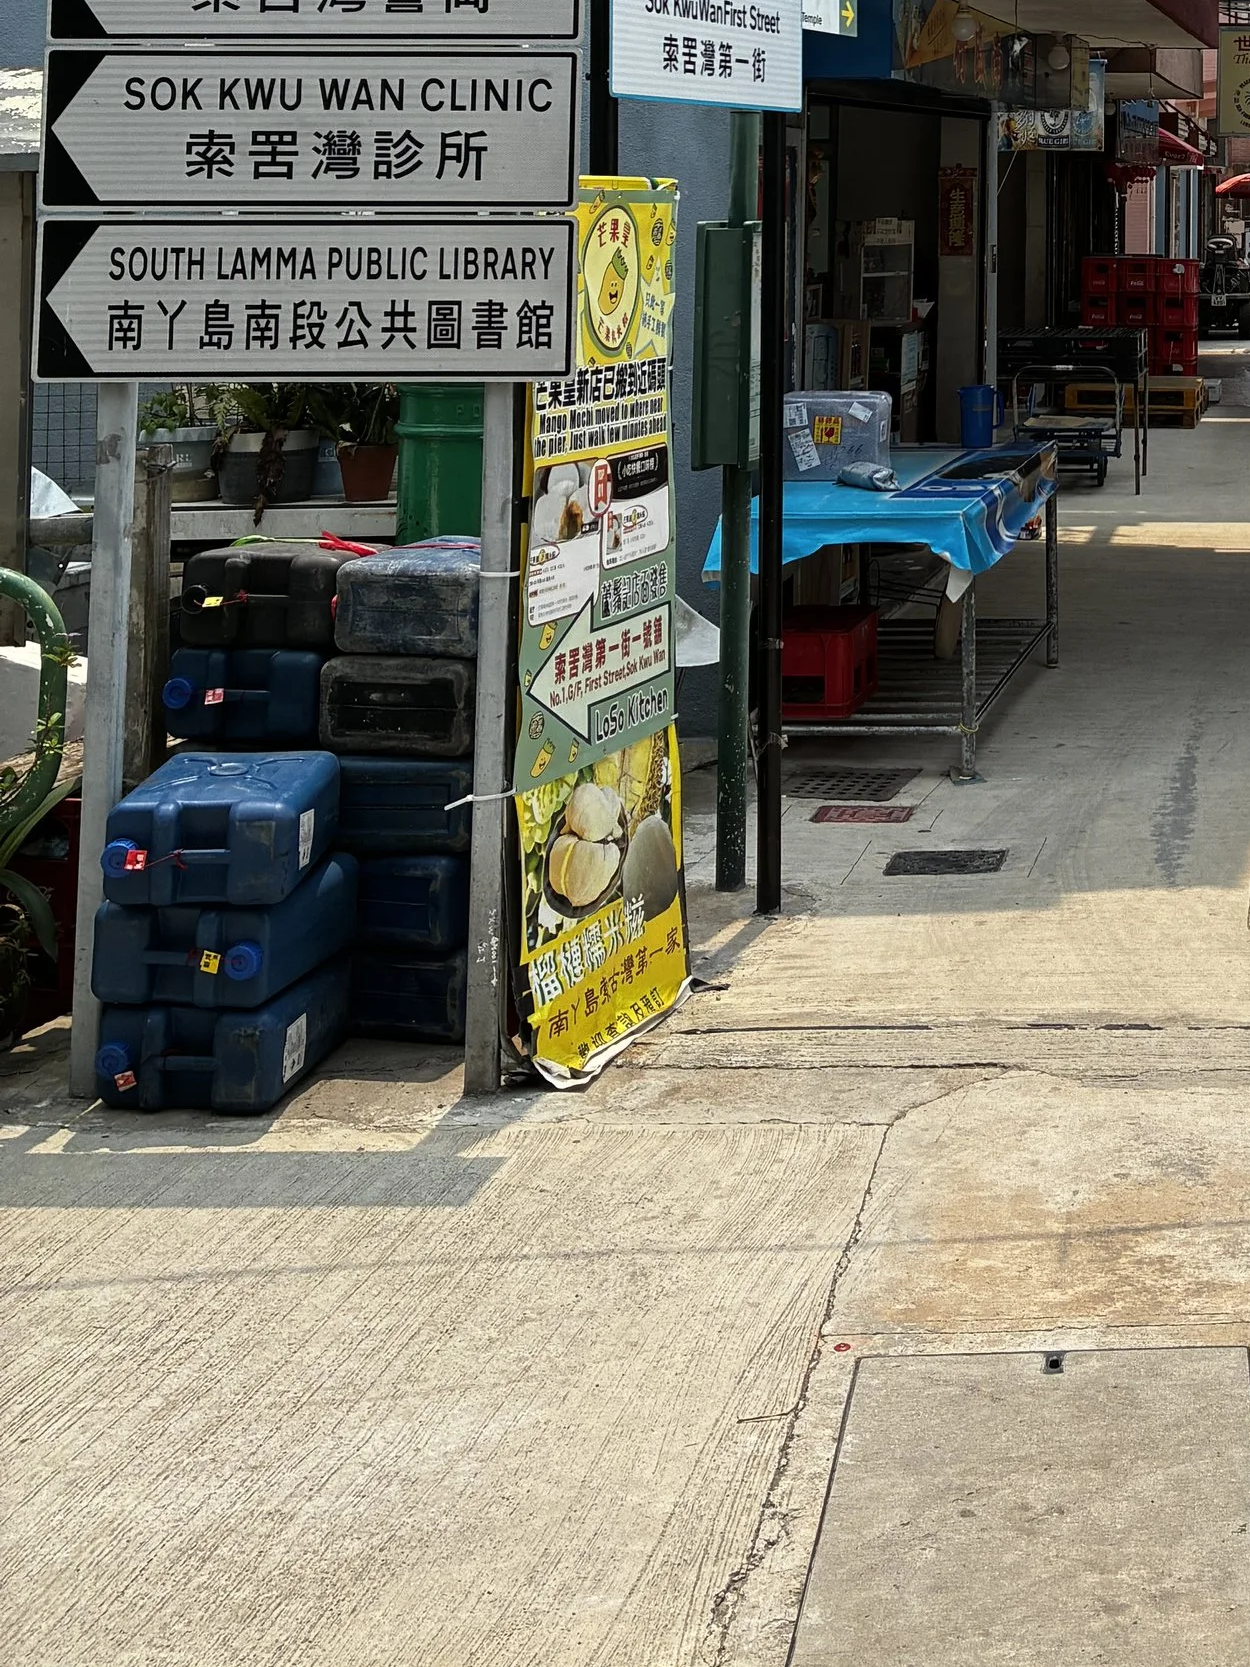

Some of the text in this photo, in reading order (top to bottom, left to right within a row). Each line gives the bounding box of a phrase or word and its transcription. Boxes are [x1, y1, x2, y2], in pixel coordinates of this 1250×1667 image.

[749, 5, 781, 35] Street
[801, 11, 822, 27] Temple
[662, 33, 766, 83] 索罟灣第一街
[123, 76, 554, 113] SOK KWU WAN CLINIC
[184, 129, 489, 181] 索罟灣診所
[109, 245, 556, 281] SOUTH LAMMA PUBLIC LIBRARY
[106, 298, 554, 351] 南丫島南段公共圖書館
[540, 396, 663, 435] Mango Mochi moved to where near
[534, 436, 547, 458] the
[569, 430, 586, 451] Just
[588, 426, 605, 447] walk
[607, 424, 620, 444] few
[584, 674, 602, 693] First
[638, 654, 653, 671] Kwu
[653, 648, 666, 665] Wan
[595, 686, 669, 744] LoSo Kitchen
